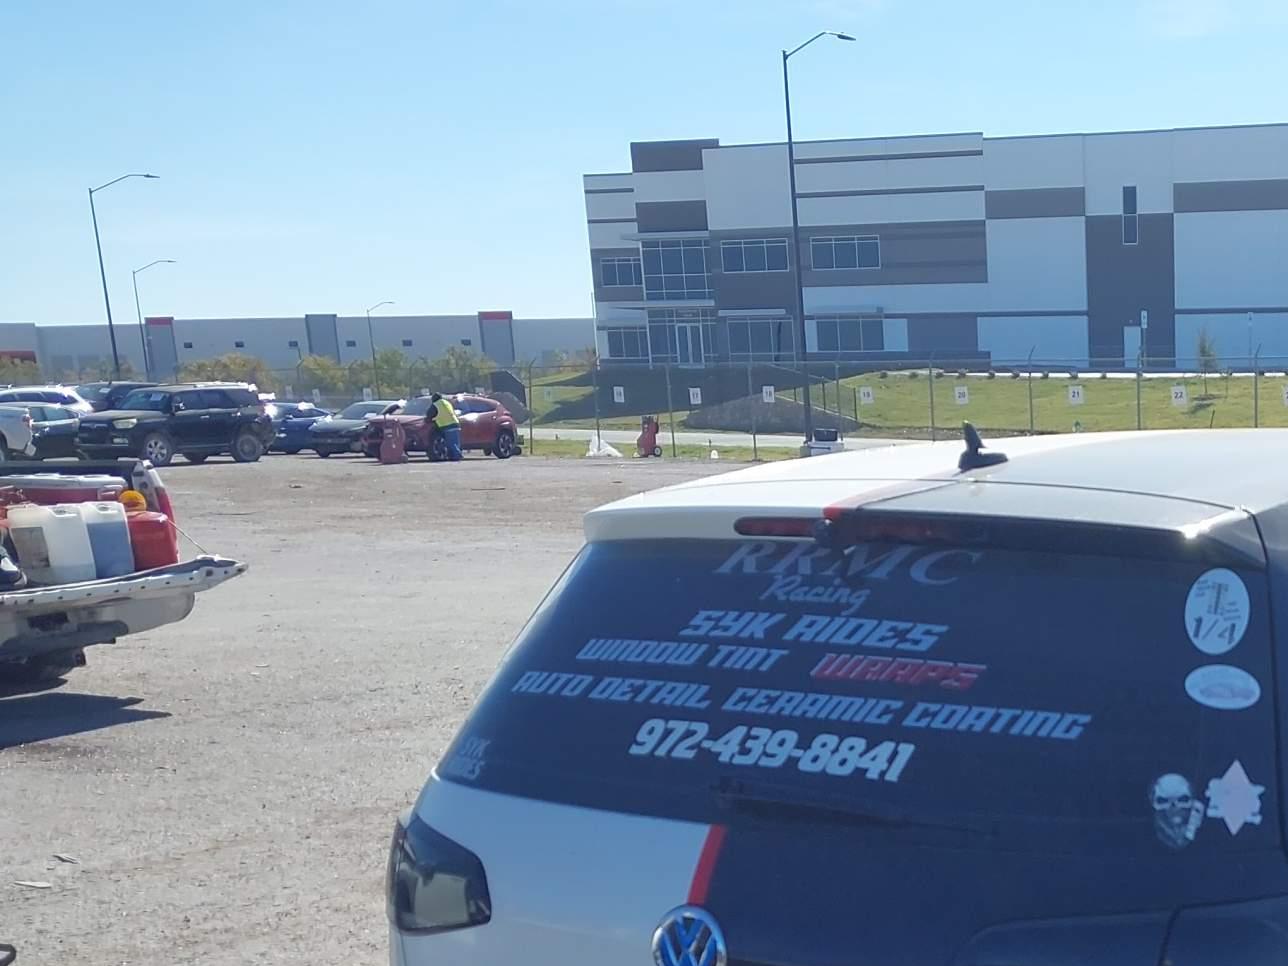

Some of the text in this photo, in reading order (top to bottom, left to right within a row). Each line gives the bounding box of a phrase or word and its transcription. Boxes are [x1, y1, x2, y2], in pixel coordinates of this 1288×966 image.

[957, 391, 966, 399] 20
[1071, 390, 1080, 398] 21
[1174, 391, 1183, 399] 22
[759, 574, 871, 615] Racing
[782, 614, 949, 651] RIDES
[576, 638, 709, 665] WINDOW
[707, 644, 789, 671] TINT
[511, 671, 1092, 740] AUTO DETAIL CERAMIC COATING
[628, 718, 915, 783] 972-439-8841
